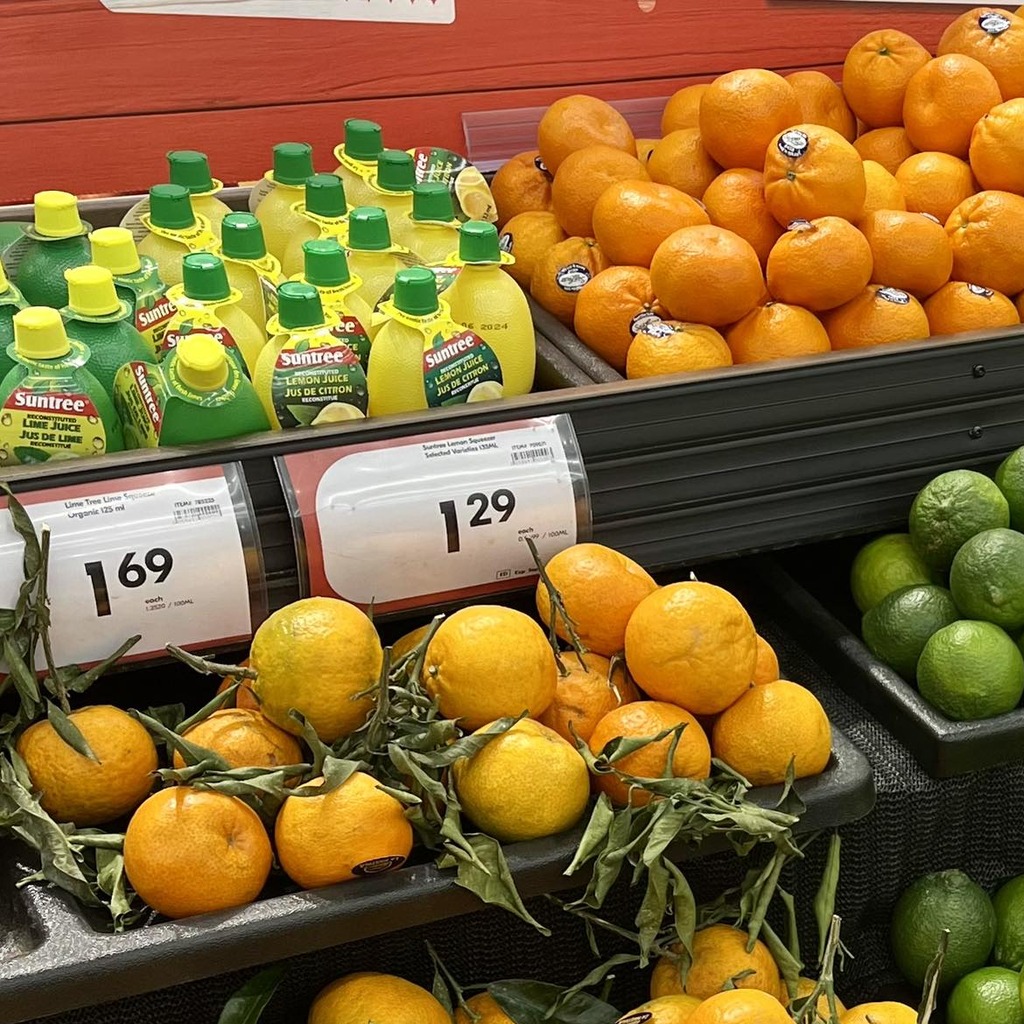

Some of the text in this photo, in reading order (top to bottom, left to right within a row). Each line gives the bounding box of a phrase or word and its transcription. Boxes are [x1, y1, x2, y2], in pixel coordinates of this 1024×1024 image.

[138, 301, 177, 326] Suntre
[481, 322, 508, 331] 2024
[280, 351, 344, 366] Suntree
[425, 335, 475, 368] Suntree
[434, 354, 484, 385] LEMON JUICE
[286, 374, 349, 386] LEMON JUICE
[436, 363, 489, 397] JUS DE CITRON
[135, 365, 159, 423] Suntree
[284, 385, 353, 398] JUS DE CITRON
[15, 392, 86, 412] Suntree
[22, 418, 82, 433] LIME JUICE
[19, 430, 83, 444] JUS DE LIME
[422, 443, 446, 451] Suntree
[447, 440, 468, 448] Lemon
[425, 449, 451, 458] Selected
[452, 446, 478, 455] Varieties
[64, 501, 84, 509] Lime
[85, 498, 102, 506] Tree
[103, 495, 122, 503] Lime
[100, 505, 114, 514] 125
[115, 503, 125, 512] ml
[518, 526, 534, 535] each
[145, 595, 163, 604] each
